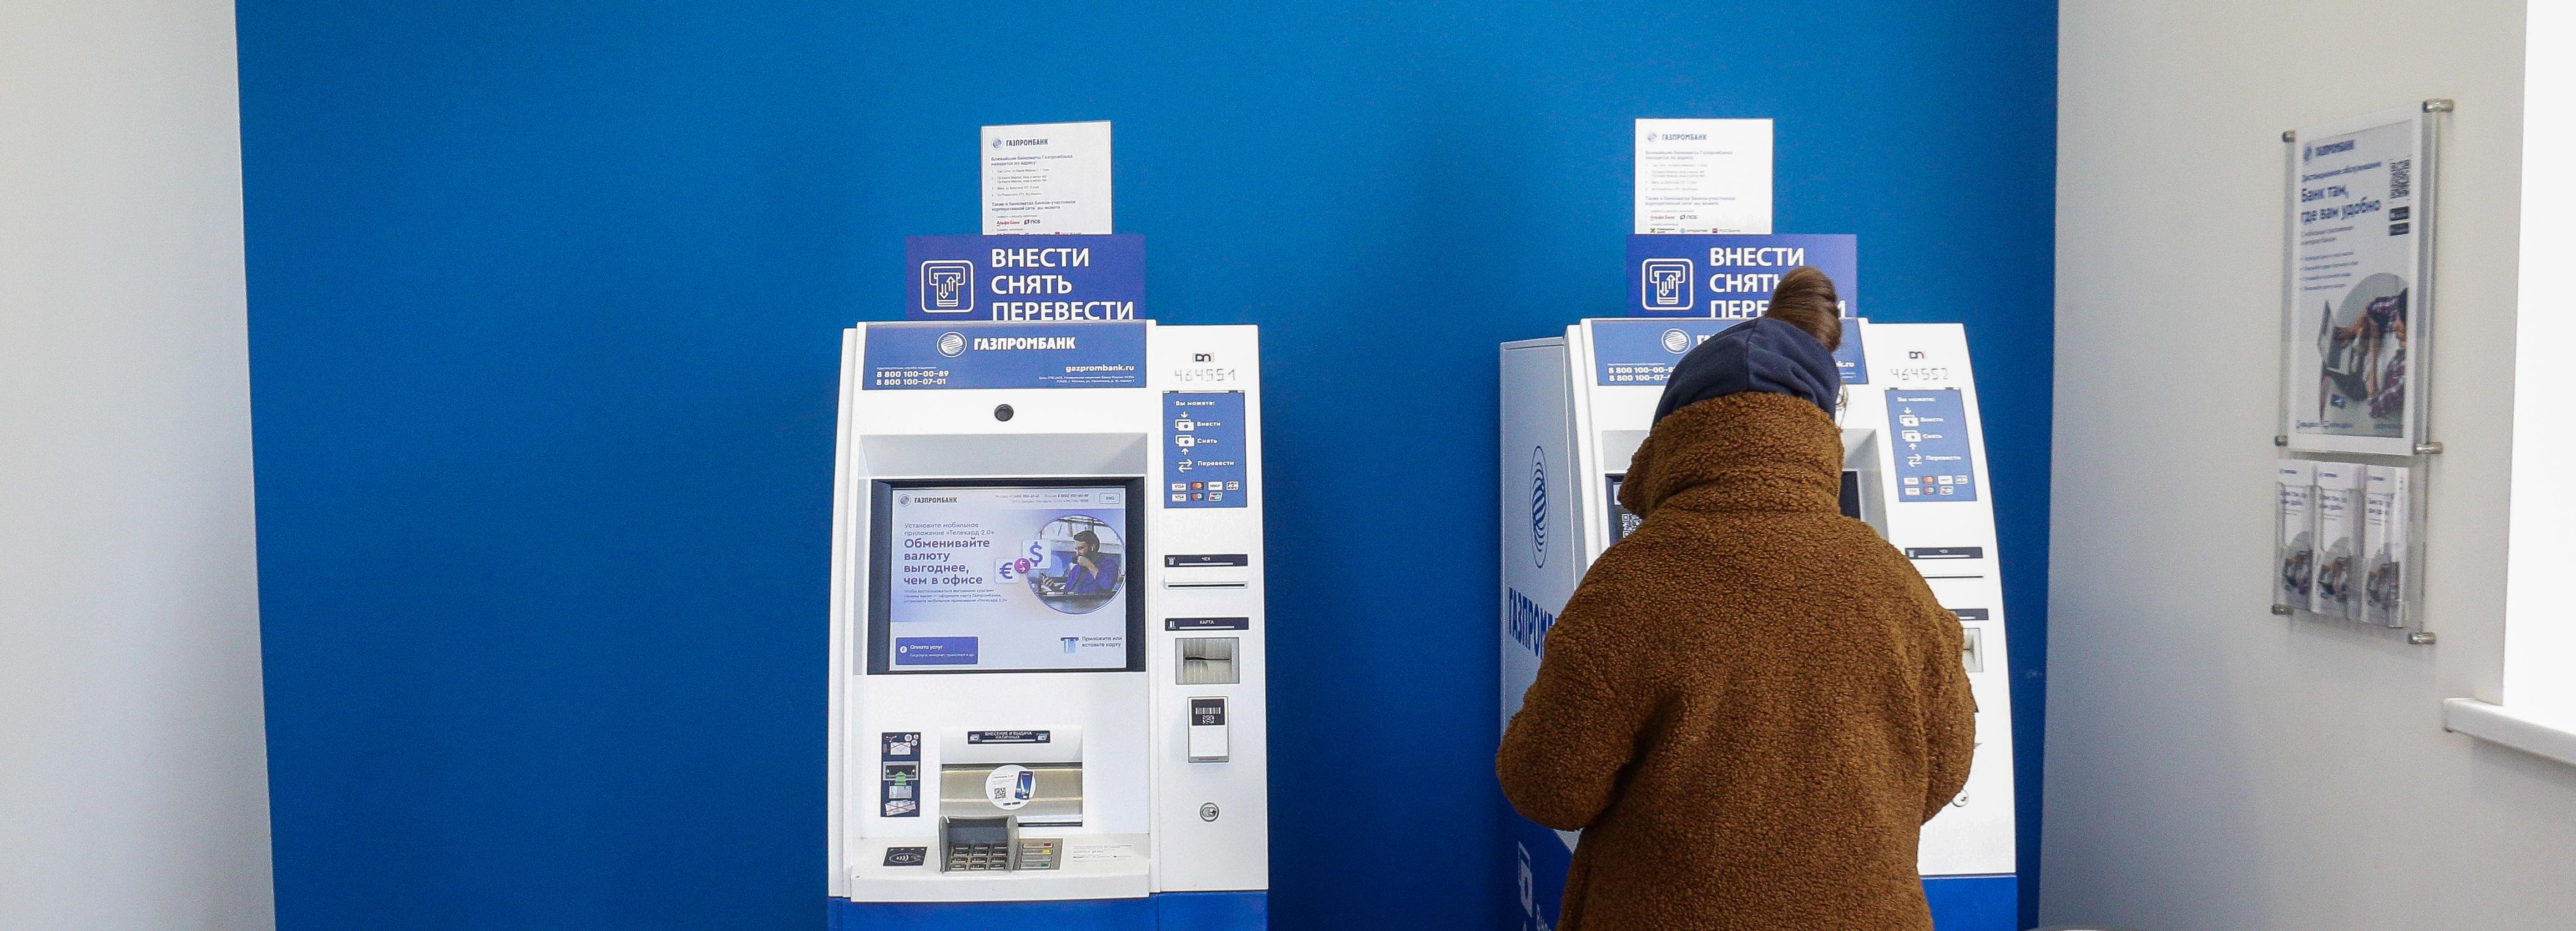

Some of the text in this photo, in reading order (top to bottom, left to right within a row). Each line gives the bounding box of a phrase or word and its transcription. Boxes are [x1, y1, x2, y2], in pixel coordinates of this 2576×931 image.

[1006, 138, 1048, 146] ГАЗПРОМБАНК
[991, 247, 1089, 267] ВНЕСТИ
[1709, 247, 1805, 267] ВНЕСТИ
[991, 275, 1072, 295] СНЯТЬ
[992, 301, 1134, 321] ПЕРЕВЕСТИ
[973, 337, 1076, 351] ГАЗПРОМБАНК
[1065, 364, 1134, 372] gazprombank.ru
[1174, 369, 1235, 381] 464551
[1890, 368, 1949, 381] 464552
[904, 537, 991, 548] Обменивайте
[904, 553, 951, 562] валюту
[903, 564, 969, 574] выгоднее,
[903, 574, 983, 586] чем в офисе
[1509, 587, 1553, 661] ГАЗПРОМ
